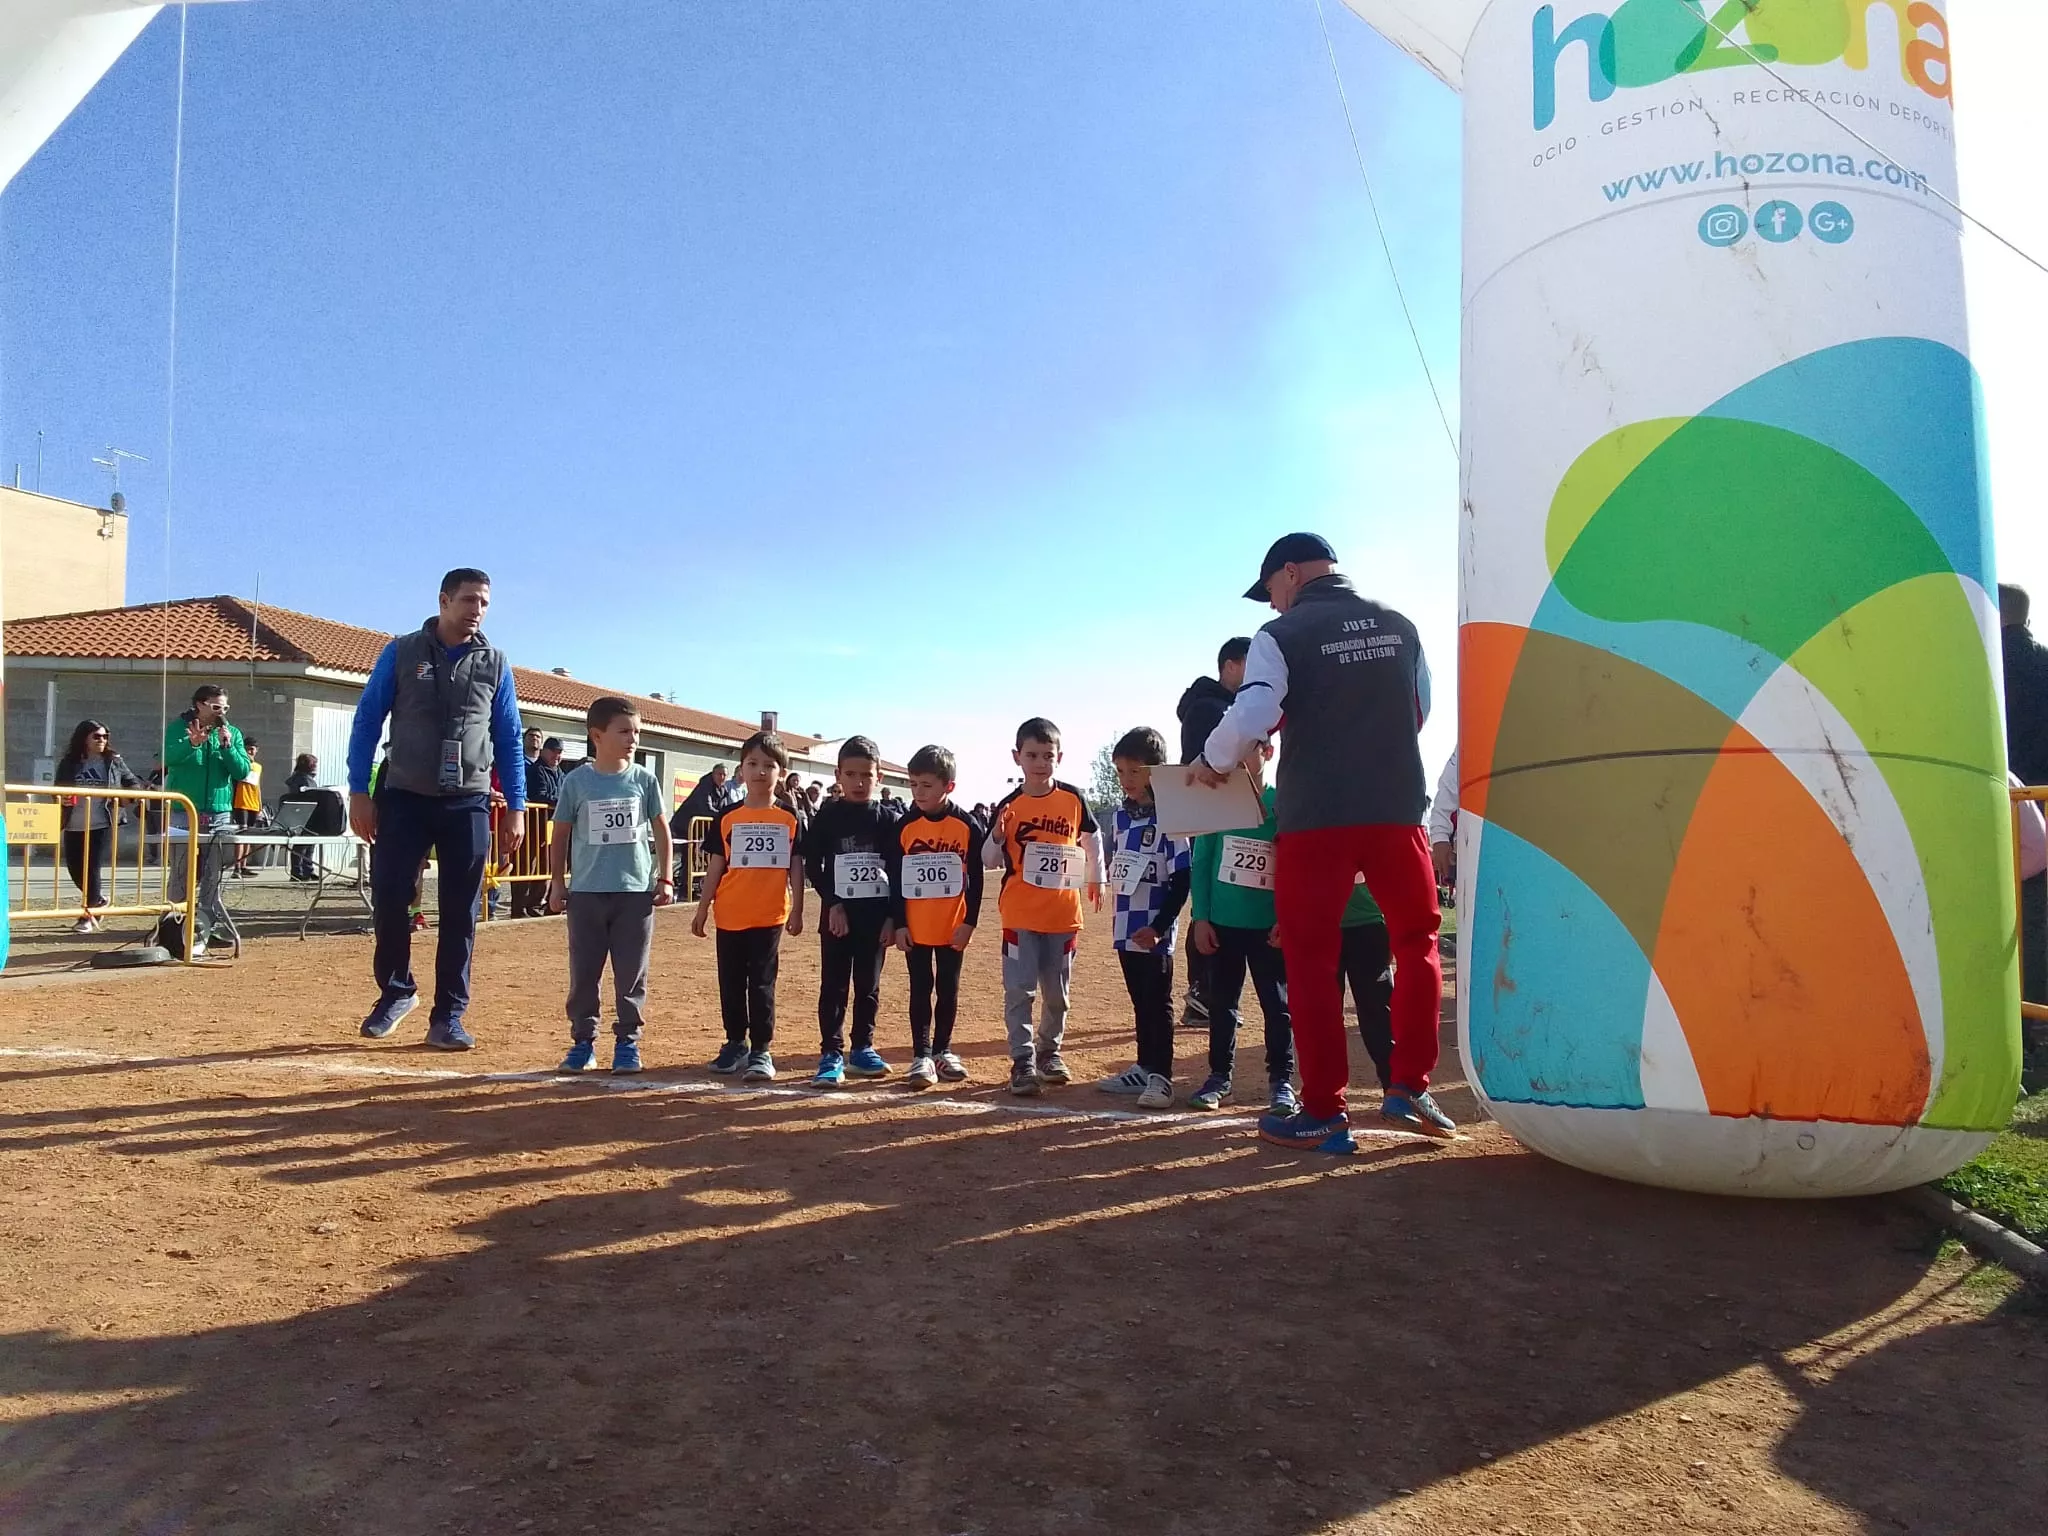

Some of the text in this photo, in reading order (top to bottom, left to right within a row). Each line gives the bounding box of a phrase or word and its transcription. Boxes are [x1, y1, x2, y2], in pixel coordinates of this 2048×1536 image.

[1533, 0, 1954, 131] hozona
[1532, 136, 1577, 168] OCIO
[1600, 96, 1703, 136] GESTIÓN
[1733, 89, 1881, 112] RECREACIÓN
[1601, 150, 1929, 202] www.hozona.com
[1342, 618, 1379, 632] JUEZ
[1320, 638, 1366, 656] FEDERACIÓN
[1339, 645, 1396, 664] DE ATLETISMO
[604, 812, 633, 828] 301
[744, 836, 775, 852] 293
[1039, 857, 1068, 874] 281
[1233, 852, 1267, 872] 229
[849, 866, 878, 882] 323
[916, 866, 948, 883] 306
